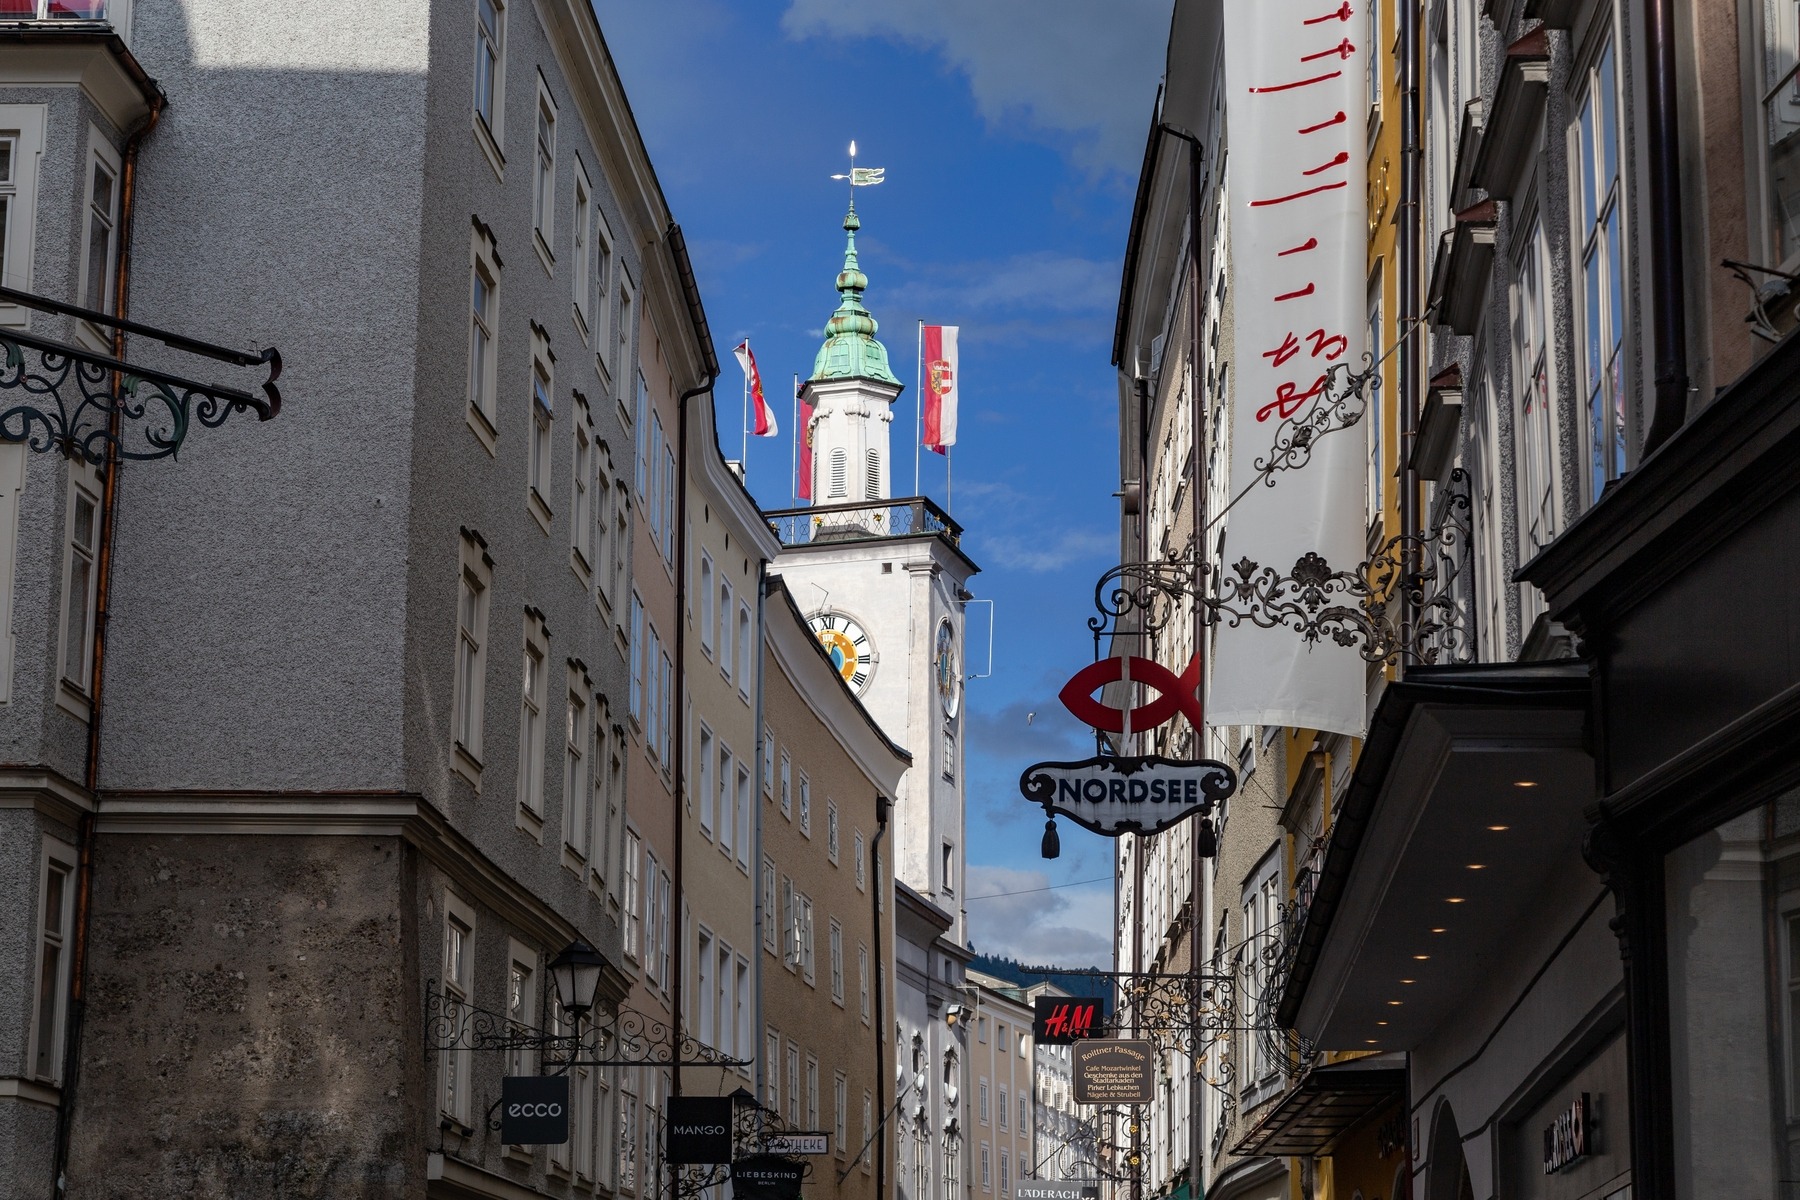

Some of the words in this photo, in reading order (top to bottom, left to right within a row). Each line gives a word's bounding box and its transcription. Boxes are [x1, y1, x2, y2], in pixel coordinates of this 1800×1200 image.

[821, 617, 836, 630] XII
[1059, 778, 1198, 803] NORDSEE
[1044, 1004, 1095, 1037] H&M
[1081, 1046, 1113, 1062] Roittner
[1114, 1045, 1146, 1062] Passage
[508, 1102, 563, 1118] ecco
[673, 1124, 726, 1136] MANGO
[736, 1171, 798, 1179] LIEBESKIND
[1018, 1188, 1080, 1200] LÄDERACH
